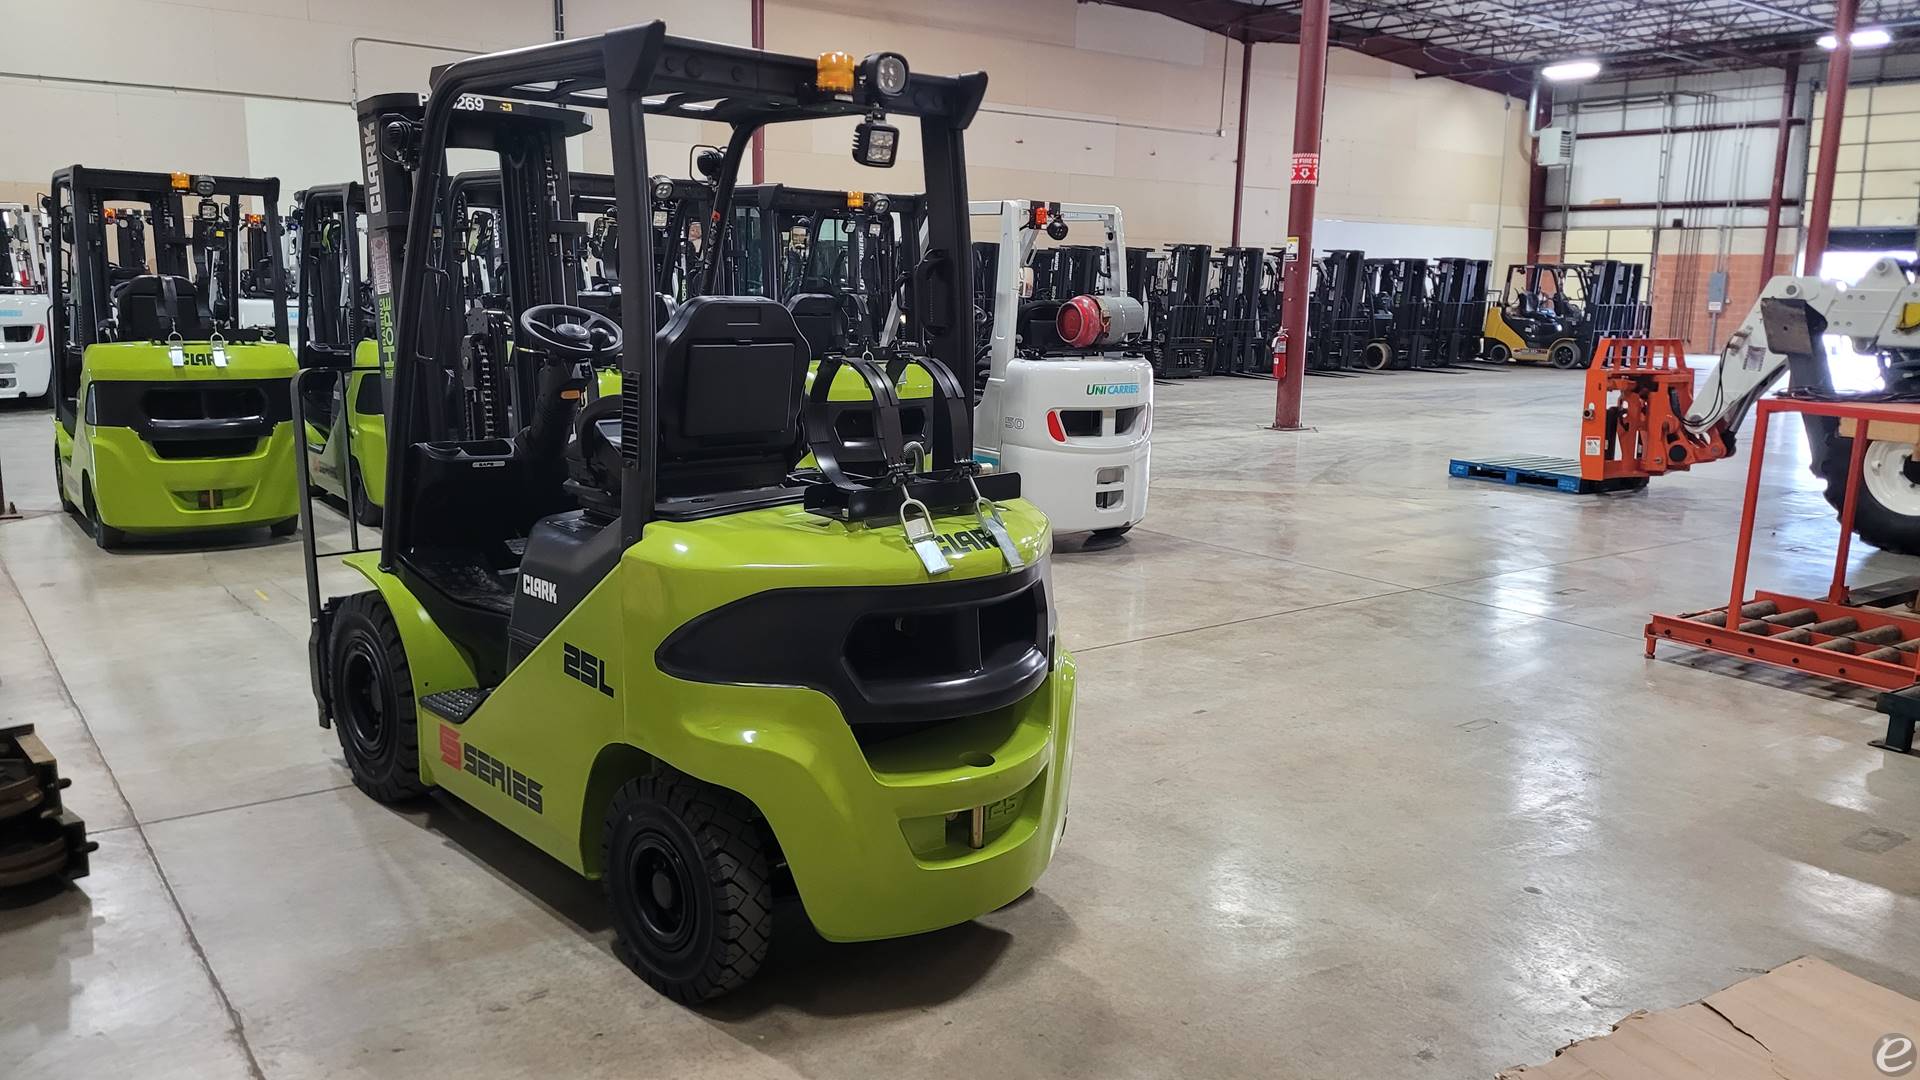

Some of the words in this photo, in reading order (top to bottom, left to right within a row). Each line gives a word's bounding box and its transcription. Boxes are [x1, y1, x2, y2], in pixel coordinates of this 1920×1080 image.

[363, 122, 382, 214] CLARK
[184, 353, 229, 366] CLAR
[382, 297, 396, 367] HOPE
[522, 573, 557, 604] CLARK
[563, 641, 614, 699] 25L
[463, 740, 544, 815] SERIES
